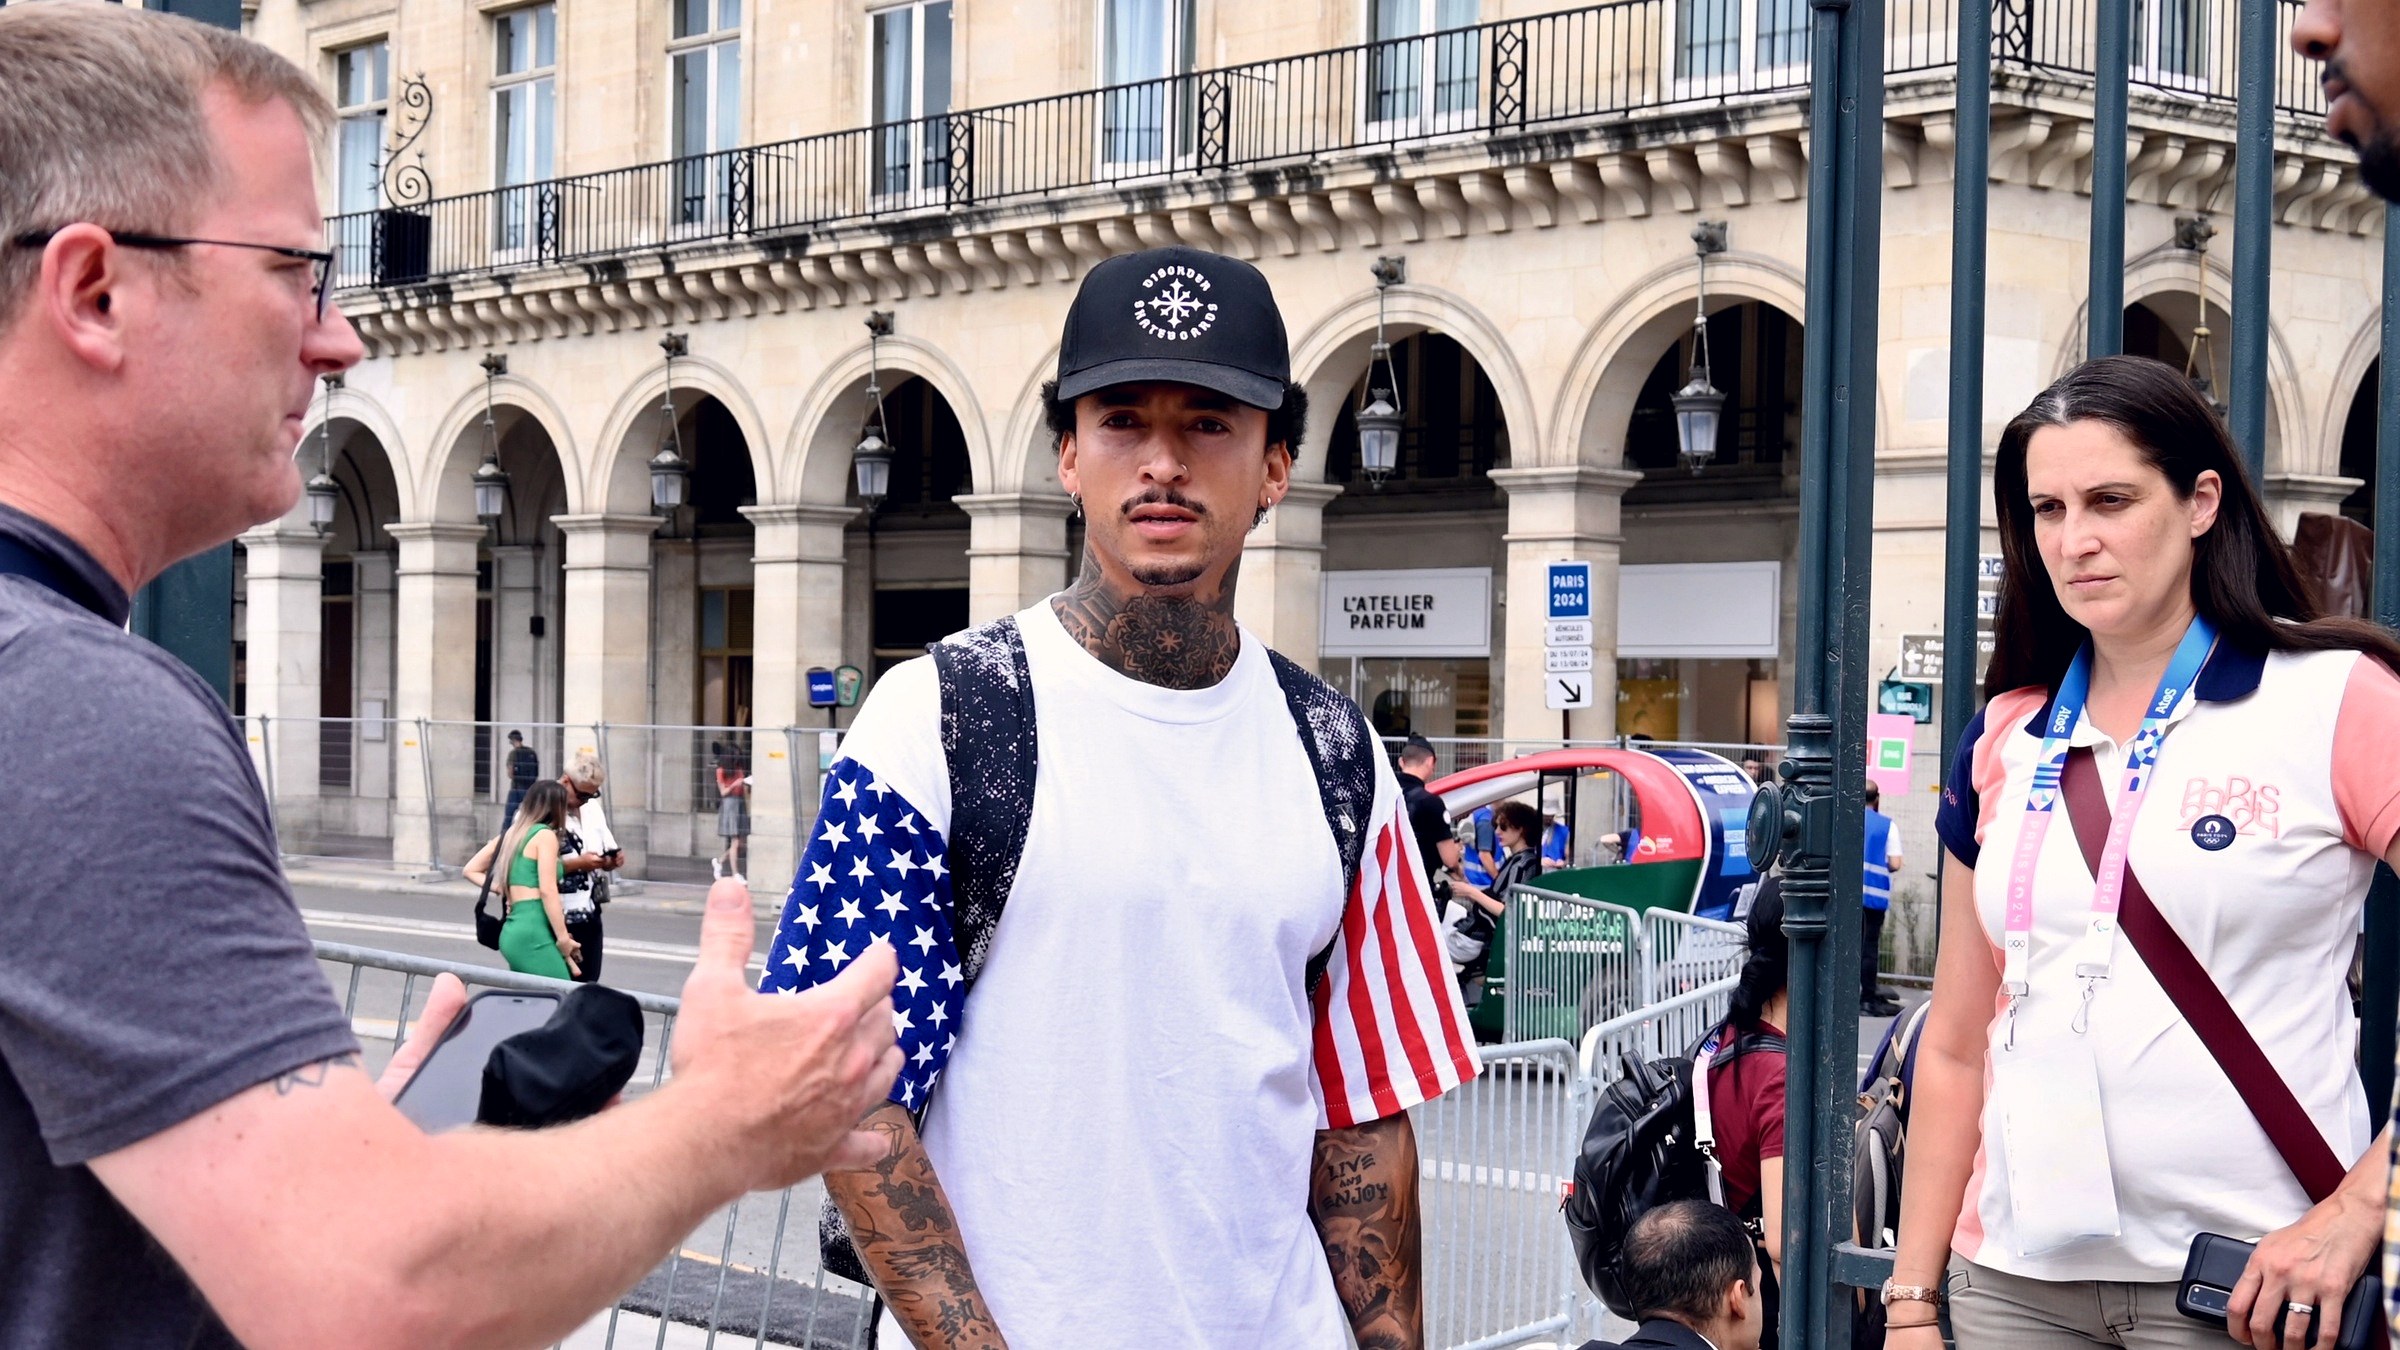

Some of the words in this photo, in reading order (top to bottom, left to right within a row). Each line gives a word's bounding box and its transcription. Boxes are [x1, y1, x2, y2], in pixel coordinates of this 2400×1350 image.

[1142, 265, 1211, 292] DISORDER
[1133, 299, 1218, 341] SKATEBOARDS
[1552, 574, 1585, 588] PARIS
[1343, 594, 1434, 612] L'ATELIER
[1553, 592, 1584, 607] 2024
[1350, 613, 1425, 629] PARFUM
[2018, 819, 2040, 869] PARIS
[2099, 851, 2120, 904] PARIS
[1328, 1153, 1376, 1181] LIVE
[1322, 1183, 1388, 1211] ENJOY
